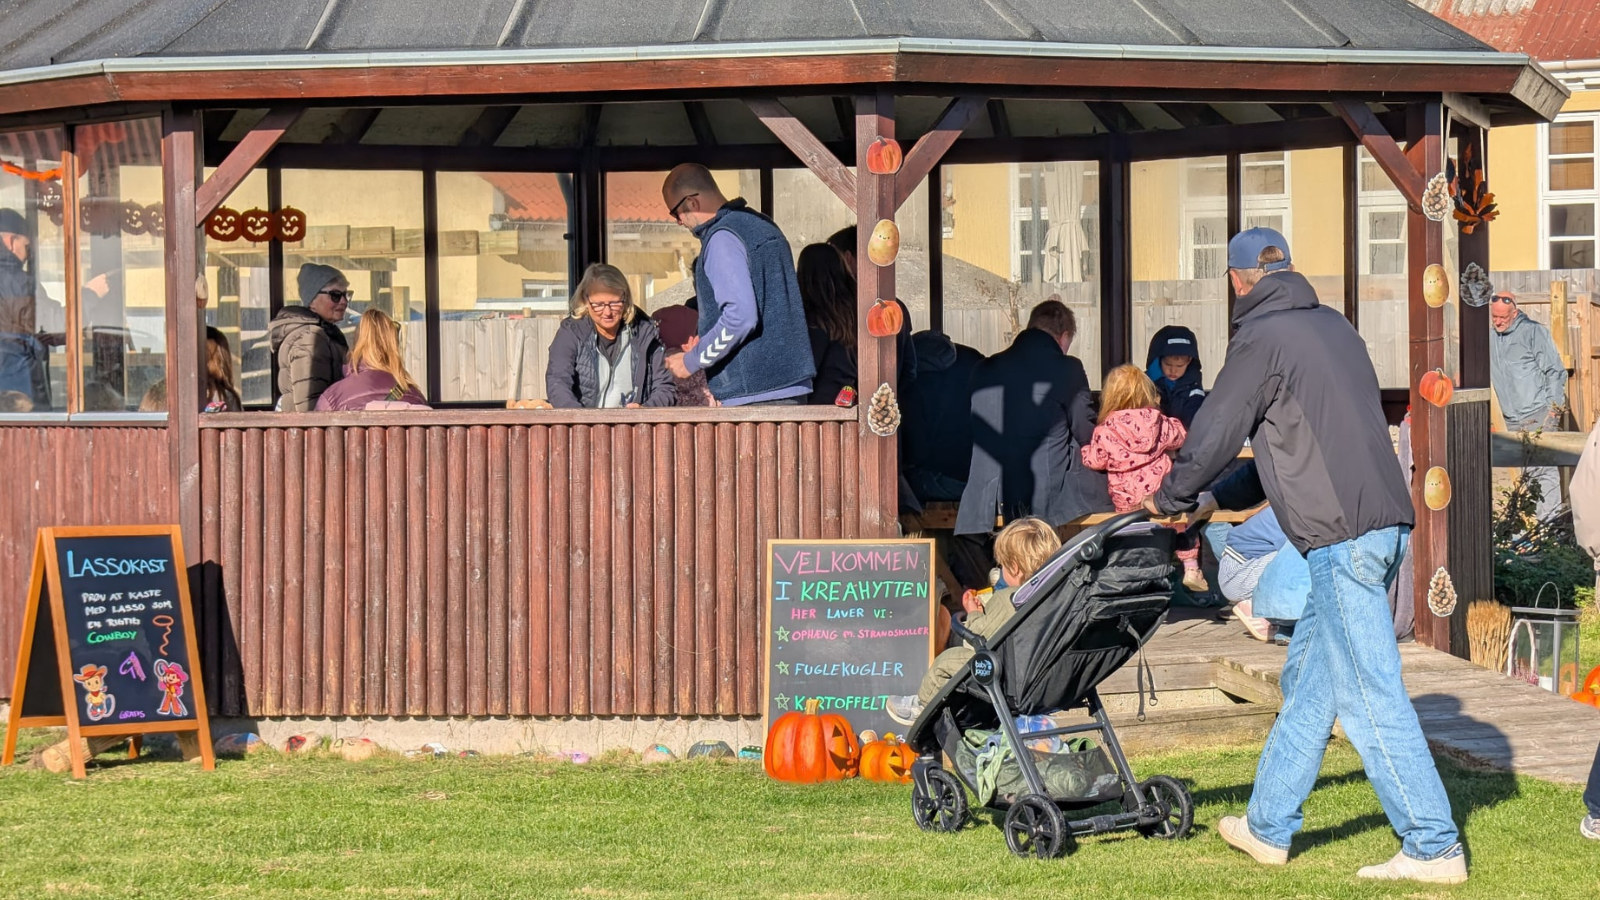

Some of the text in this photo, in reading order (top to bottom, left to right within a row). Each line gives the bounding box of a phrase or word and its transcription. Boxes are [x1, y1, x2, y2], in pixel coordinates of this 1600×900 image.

[67, 550, 168, 577] LASSOKAST
[775, 550, 919, 575] VELKOMMEN
[82, 593, 106, 603] PRØV
[128, 590, 162, 599] KASTE
[775, 580, 928, 602] I KREAHYTTEN
[85, 601, 172, 616] MED LASSO SOM
[791, 607, 816, 620] HER
[826, 607, 865, 619] LAVER
[106, 618, 141, 626] RIGTIG
[791, 628, 838, 640] OPHÆNG
[857, 627, 929, 639] STRANDSKALLER
[794, 661, 904, 677] FUGLEKUGLER
[974, 660, 986, 670] baby
